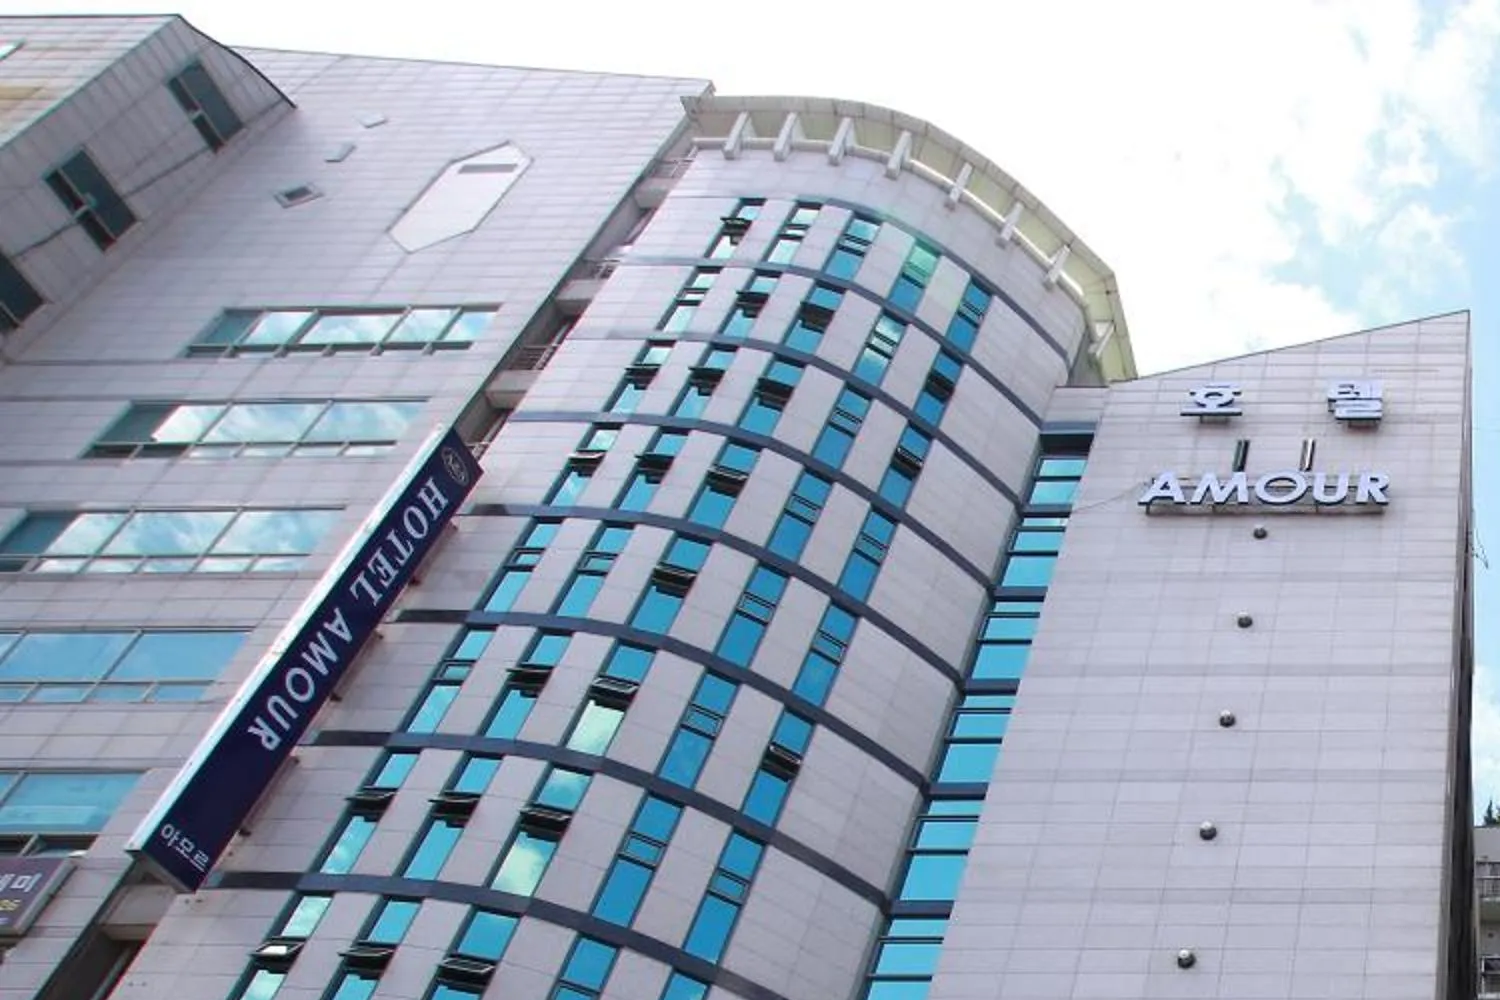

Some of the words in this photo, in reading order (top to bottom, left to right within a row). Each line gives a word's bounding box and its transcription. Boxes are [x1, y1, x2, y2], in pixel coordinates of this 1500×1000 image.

[1138, 470, 1390, 506] AMOUR
[350, 478, 449, 606] HOTEL
[248, 607, 354, 752] AMOUR
[161, 823, 210, 874] 아모르
